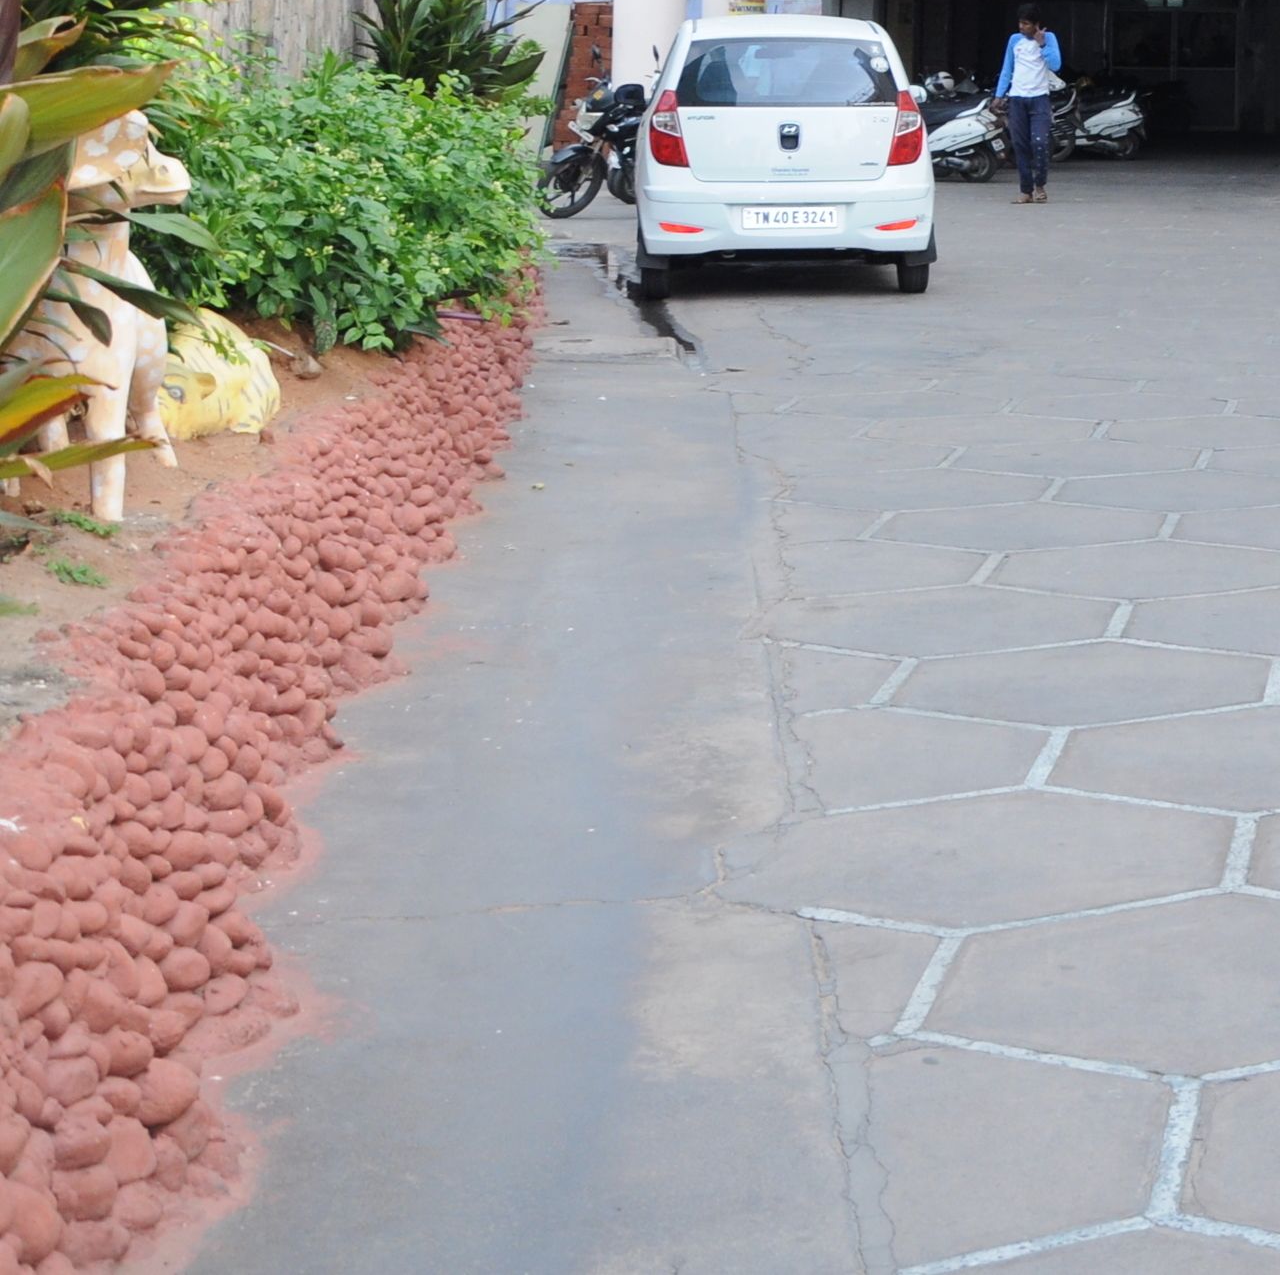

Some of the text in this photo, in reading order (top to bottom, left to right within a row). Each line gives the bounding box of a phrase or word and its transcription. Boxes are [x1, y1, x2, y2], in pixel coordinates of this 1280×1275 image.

[754, 210, 834, 224] TN 40 E 3241
